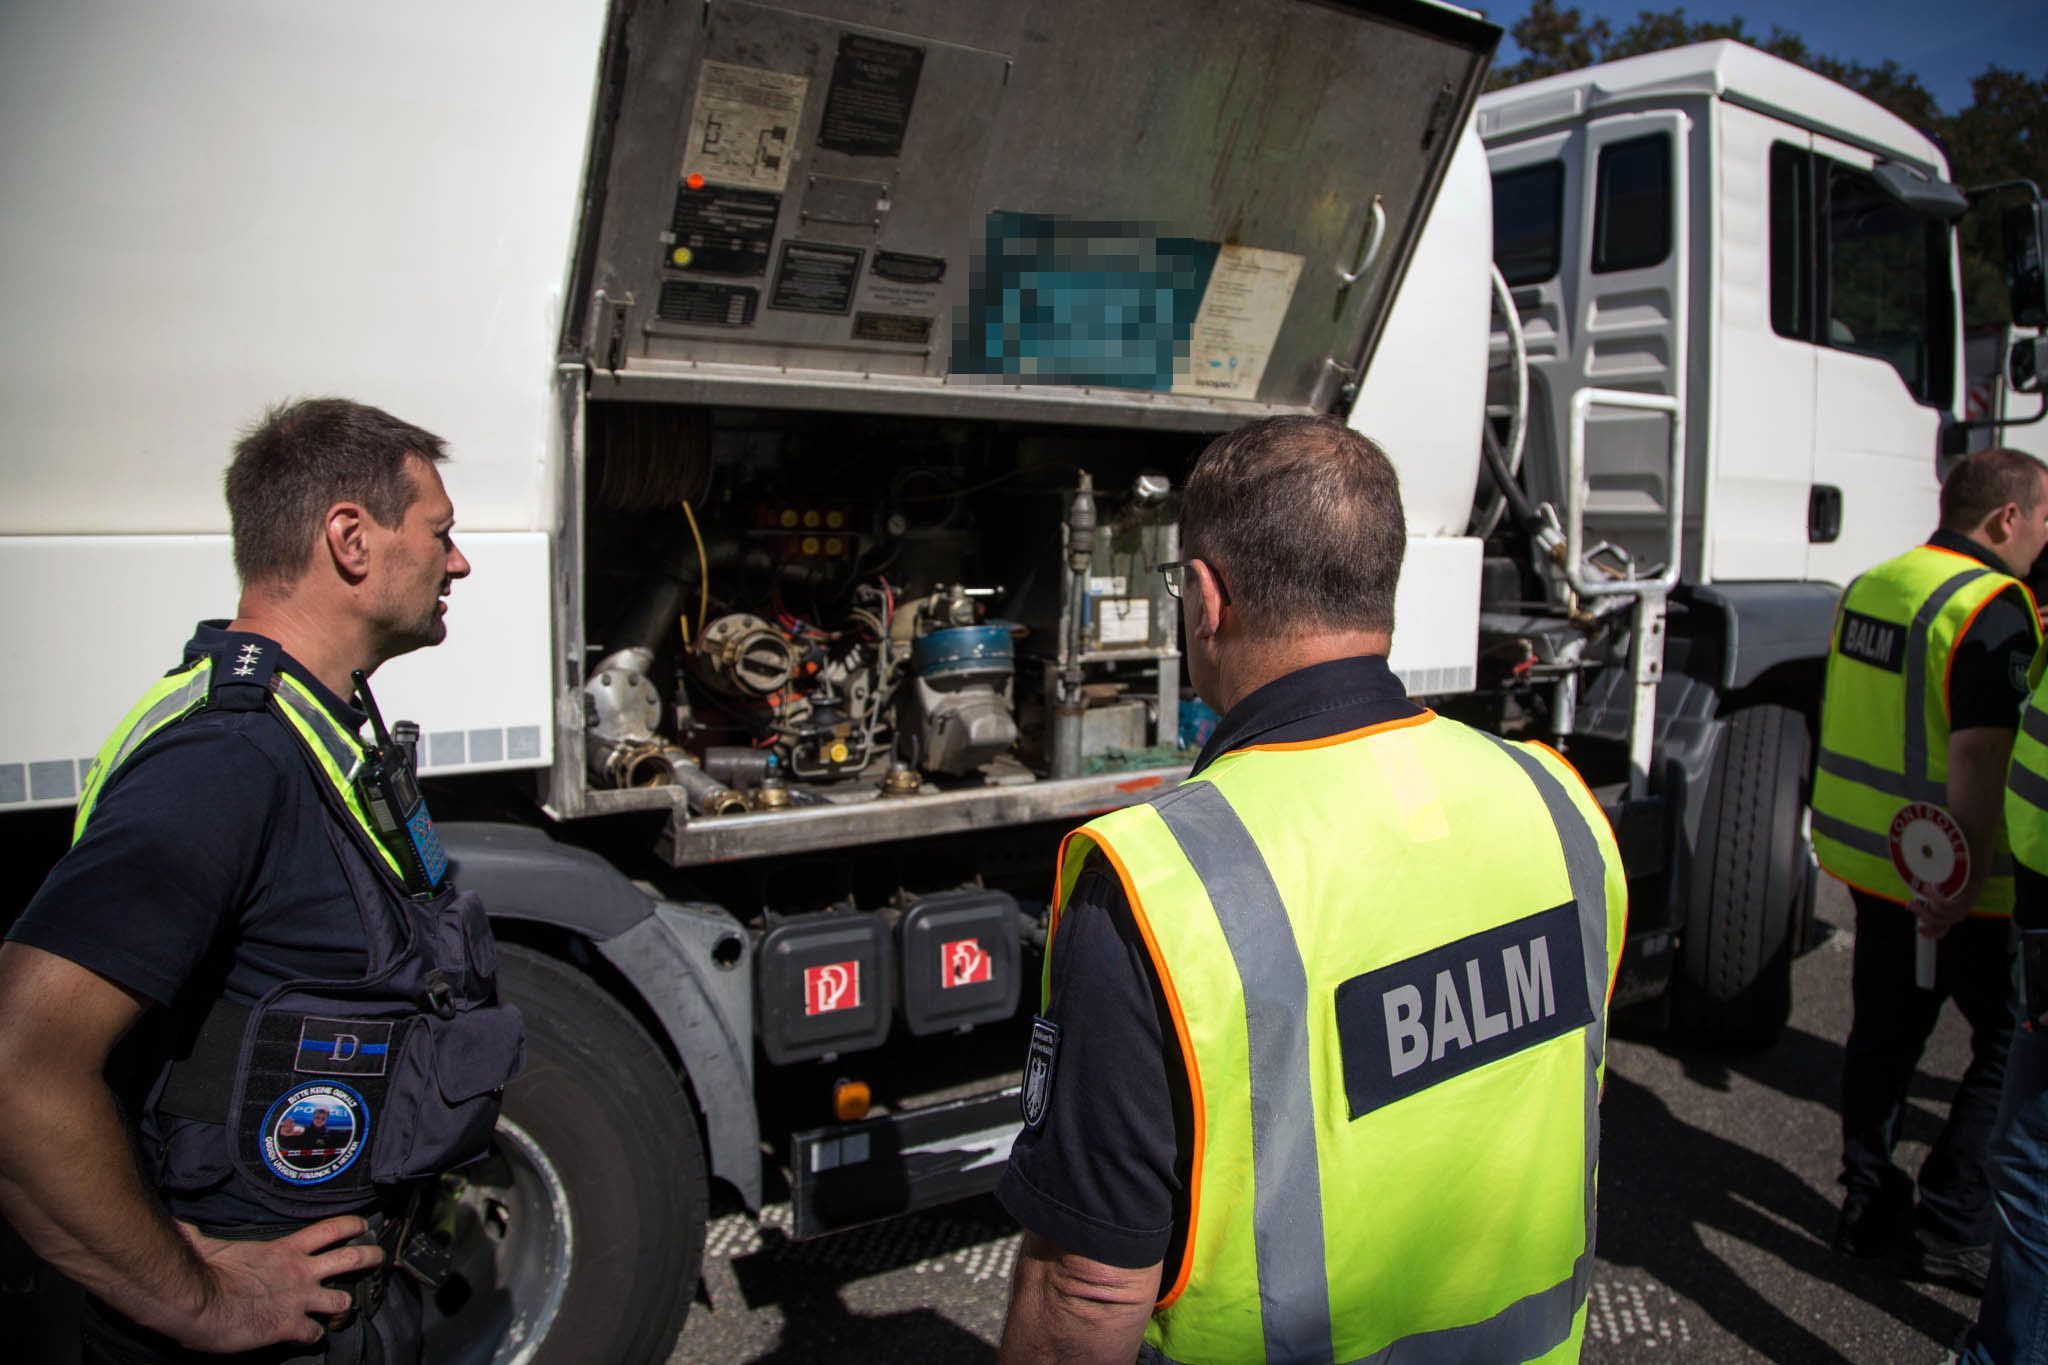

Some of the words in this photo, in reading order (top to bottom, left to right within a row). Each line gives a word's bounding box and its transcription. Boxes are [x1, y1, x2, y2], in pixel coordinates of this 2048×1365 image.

[1845, 618, 1895, 664] BALM
[1891, 804, 1967, 861] KONTROLLE
[1382, 935, 1556, 1078] BALM
[328, 1032, 360, 1062] D
[287, 1088, 310, 1105] BITTE
[309, 1086, 333, 1095] KEINE
